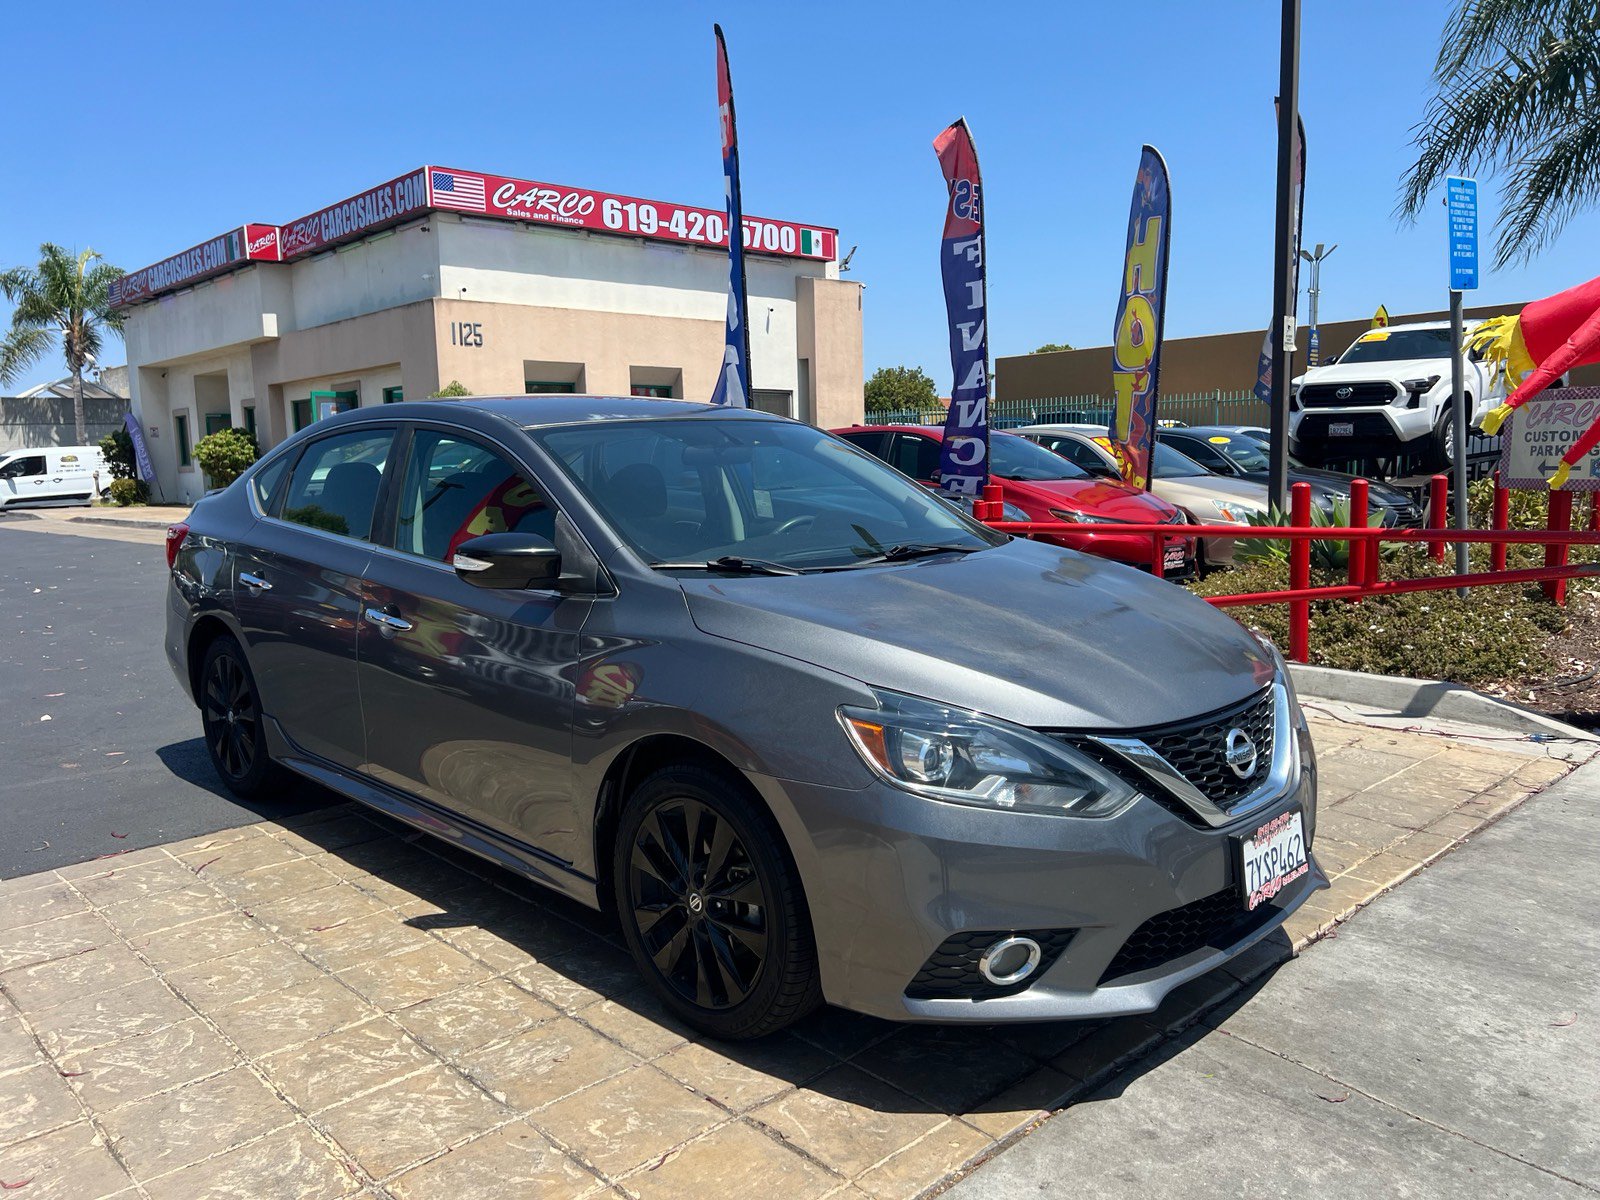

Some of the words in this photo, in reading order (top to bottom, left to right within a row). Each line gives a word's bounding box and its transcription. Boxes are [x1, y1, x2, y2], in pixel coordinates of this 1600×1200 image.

[281, 216, 320, 254] CARCO
[321, 173, 426, 242] CARCOSALES.COM
[492, 182, 595, 217] CARCO
[506, 208, 531, 219] Sales
[533, 212, 549, 220] and
[551, 213, 584, 225] Finance
[248, 232, 276, 253] CARCO
[147, 238, 227, 292] CARCOSALES.COM
[451, 321, 483, 348] 1125
[1113, 215, 1162, 445] HOT
[1524, 430, 1587, 443] CUSTOM
[1529, 445, 1600, 456] PARKG
[1246, 833, 1304, 891] 7YSP462
